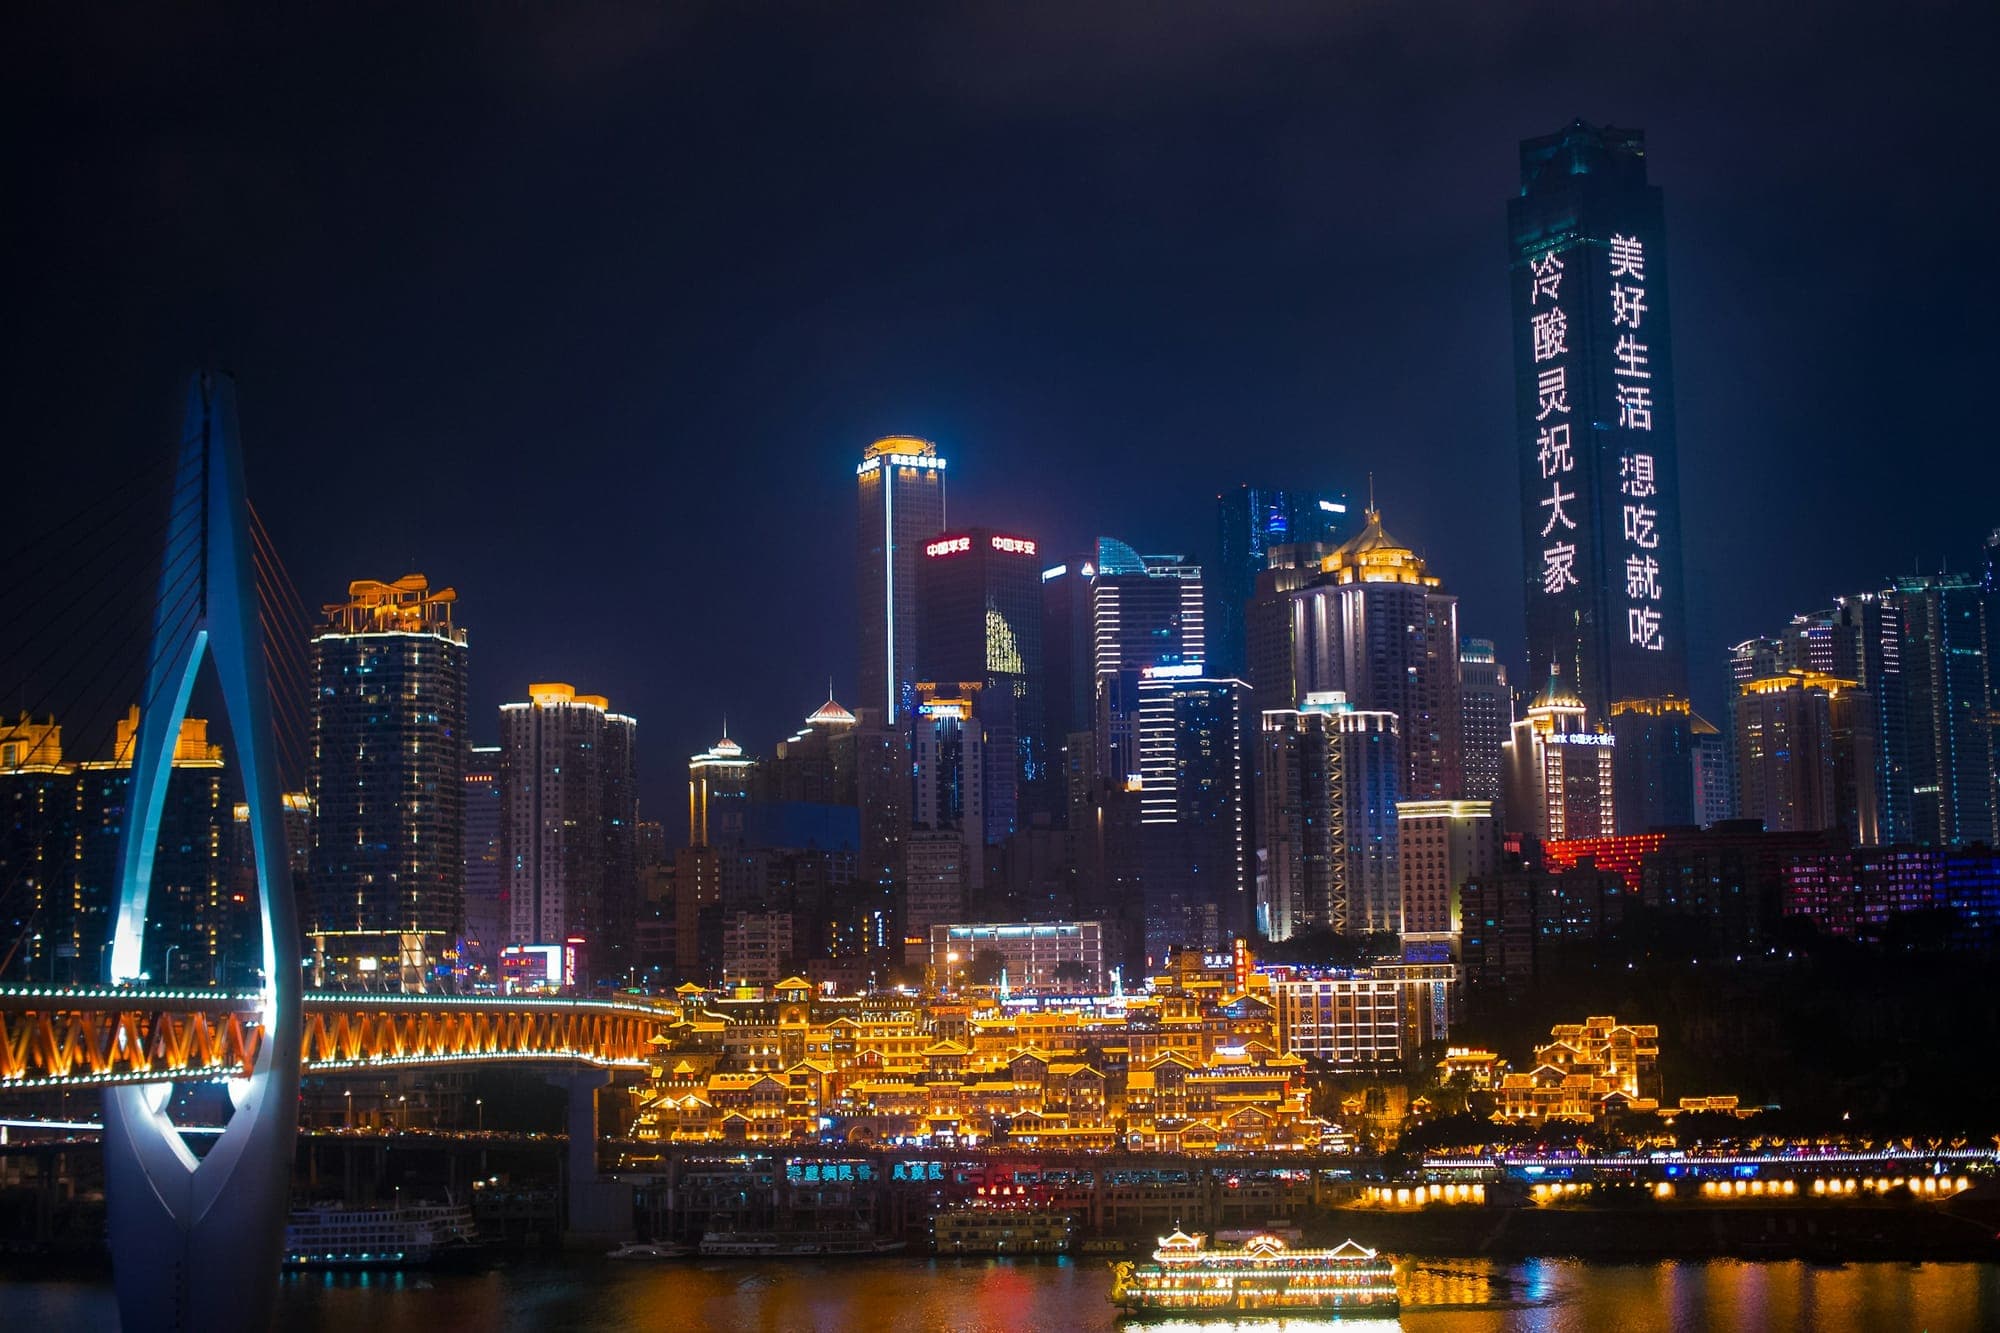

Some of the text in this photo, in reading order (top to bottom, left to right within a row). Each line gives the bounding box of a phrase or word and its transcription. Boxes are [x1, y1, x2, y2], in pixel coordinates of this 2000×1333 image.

[1530, 250, 1579, 594] 冷酸灵祝大家
[1608, 233, 1665, 651] 美好生活 想吃就吃
[926, 537, 970, 557] 中国平安
[991, 536, 1036, 556] 中国平安
